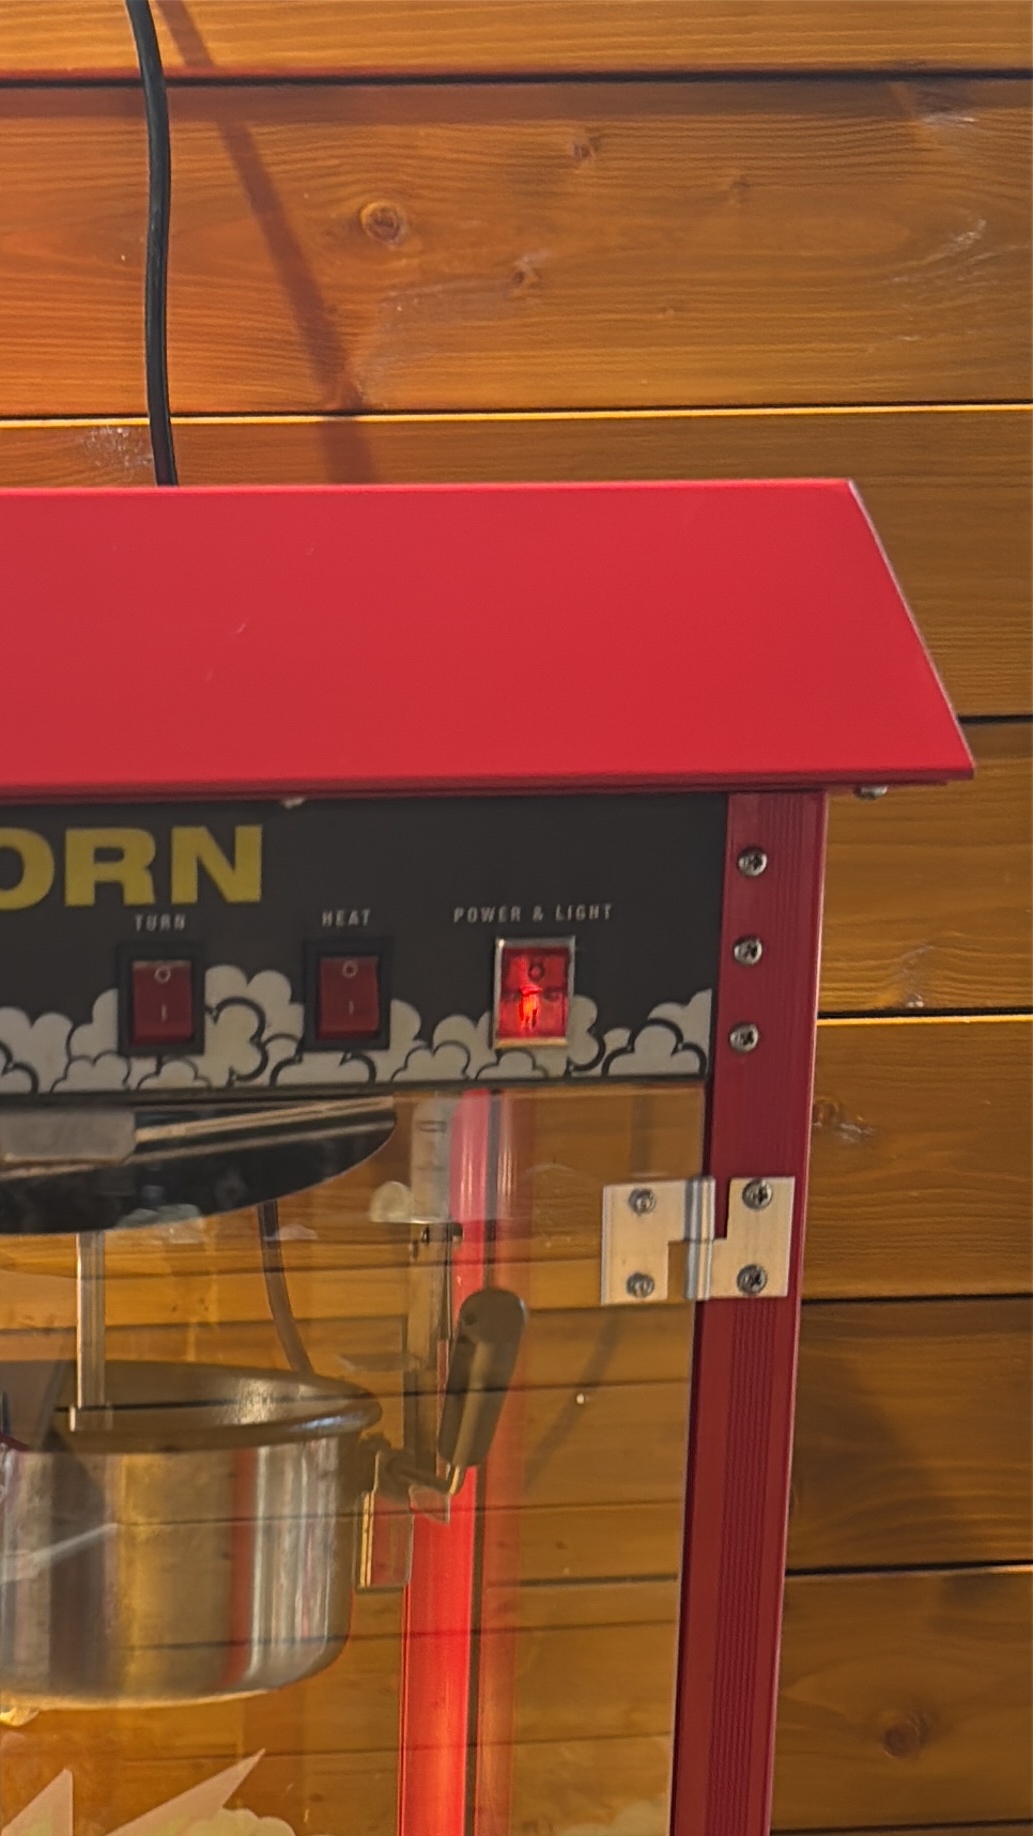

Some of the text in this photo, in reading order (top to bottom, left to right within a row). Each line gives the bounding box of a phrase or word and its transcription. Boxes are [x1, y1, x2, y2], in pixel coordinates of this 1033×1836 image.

[134, 913, 186, 932] TURN
[321, 908, 372, 927] HEAT
[453, 903, 613, 923] POWER & LIGHT
